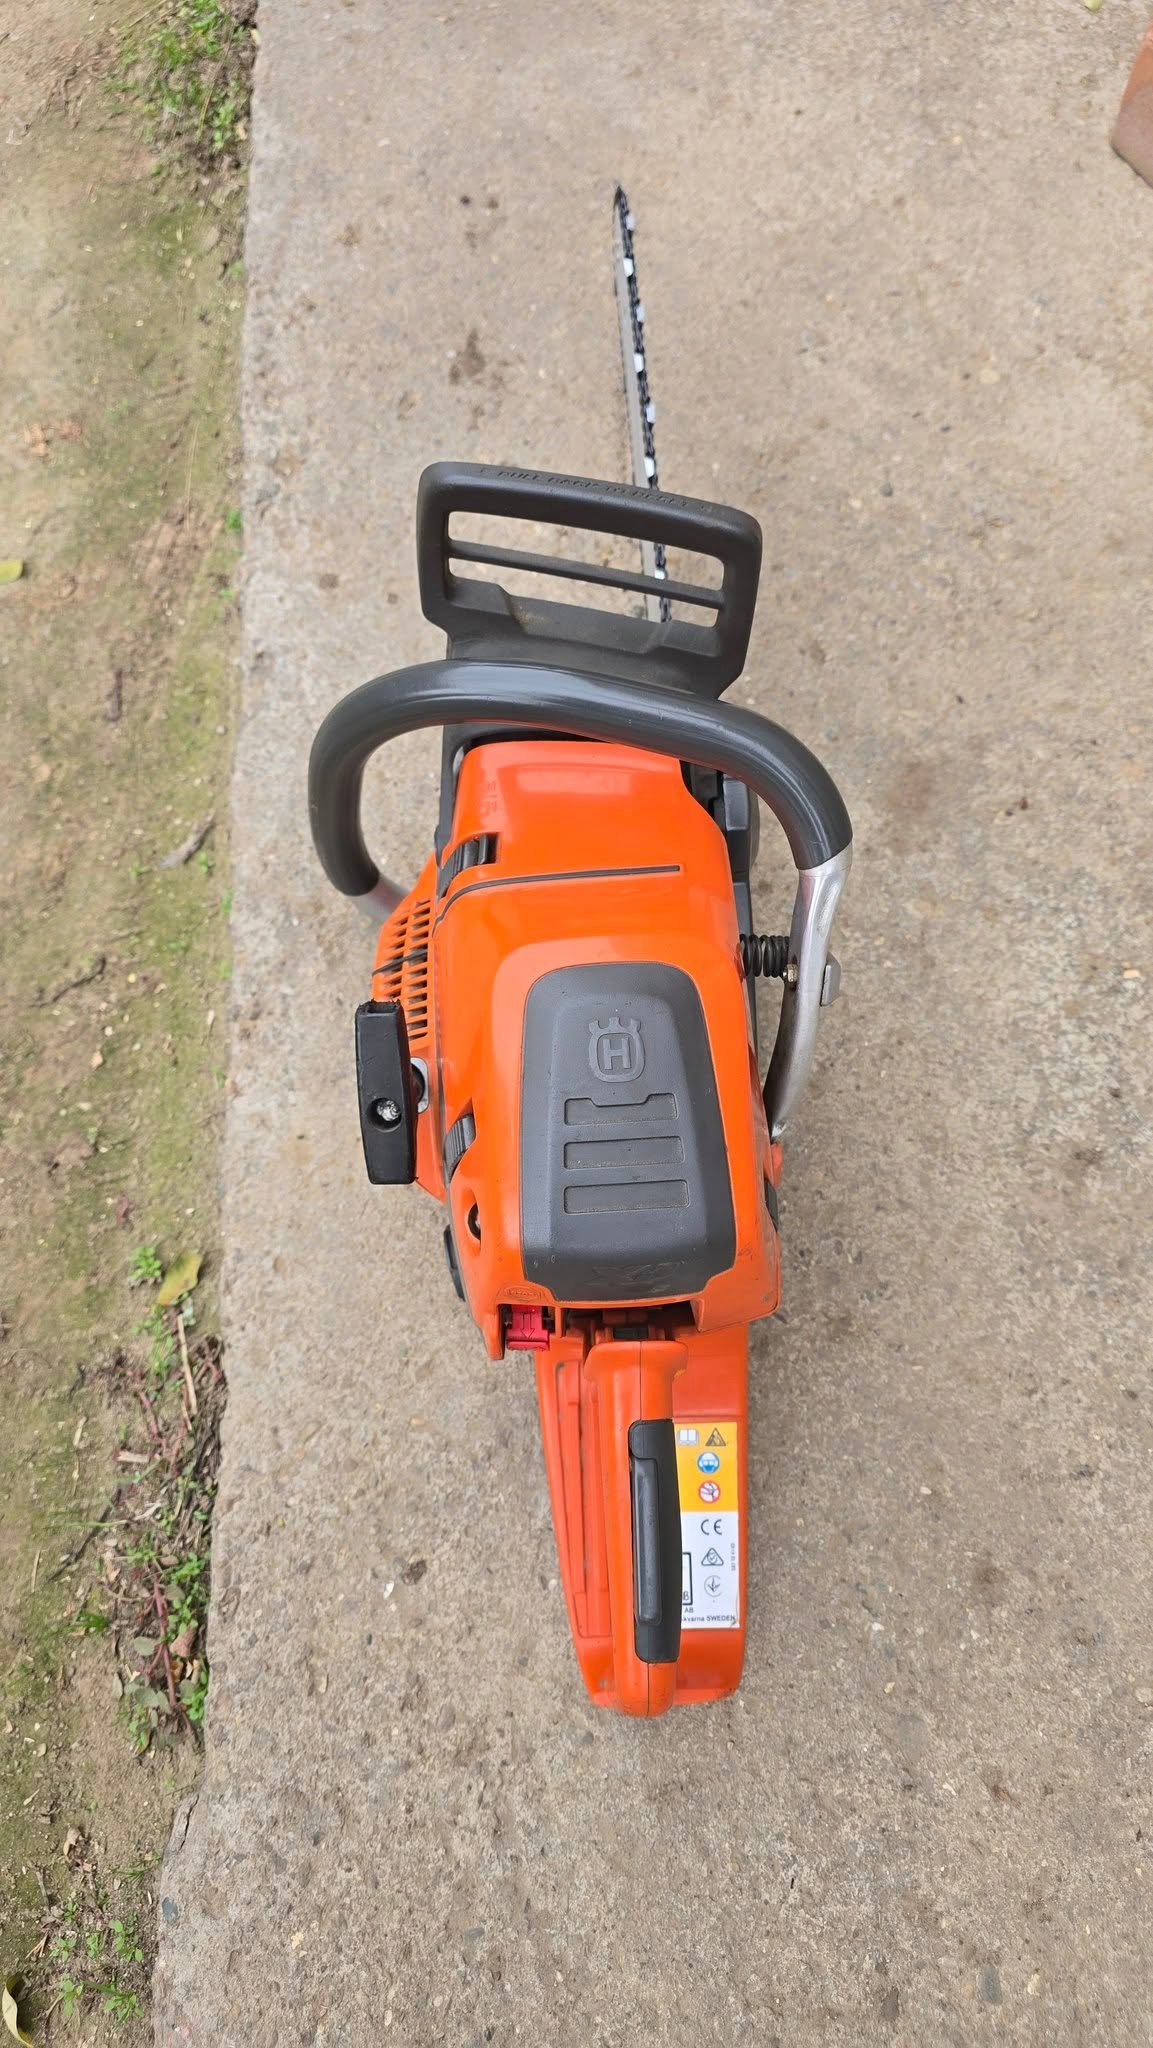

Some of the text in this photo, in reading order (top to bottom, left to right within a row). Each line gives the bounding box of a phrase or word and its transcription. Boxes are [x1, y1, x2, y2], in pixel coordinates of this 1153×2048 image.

[547, 476, 598, 489] BACK
[602, 1038, 631, 1070] H
[701, 1519, 722, 1535] CE
